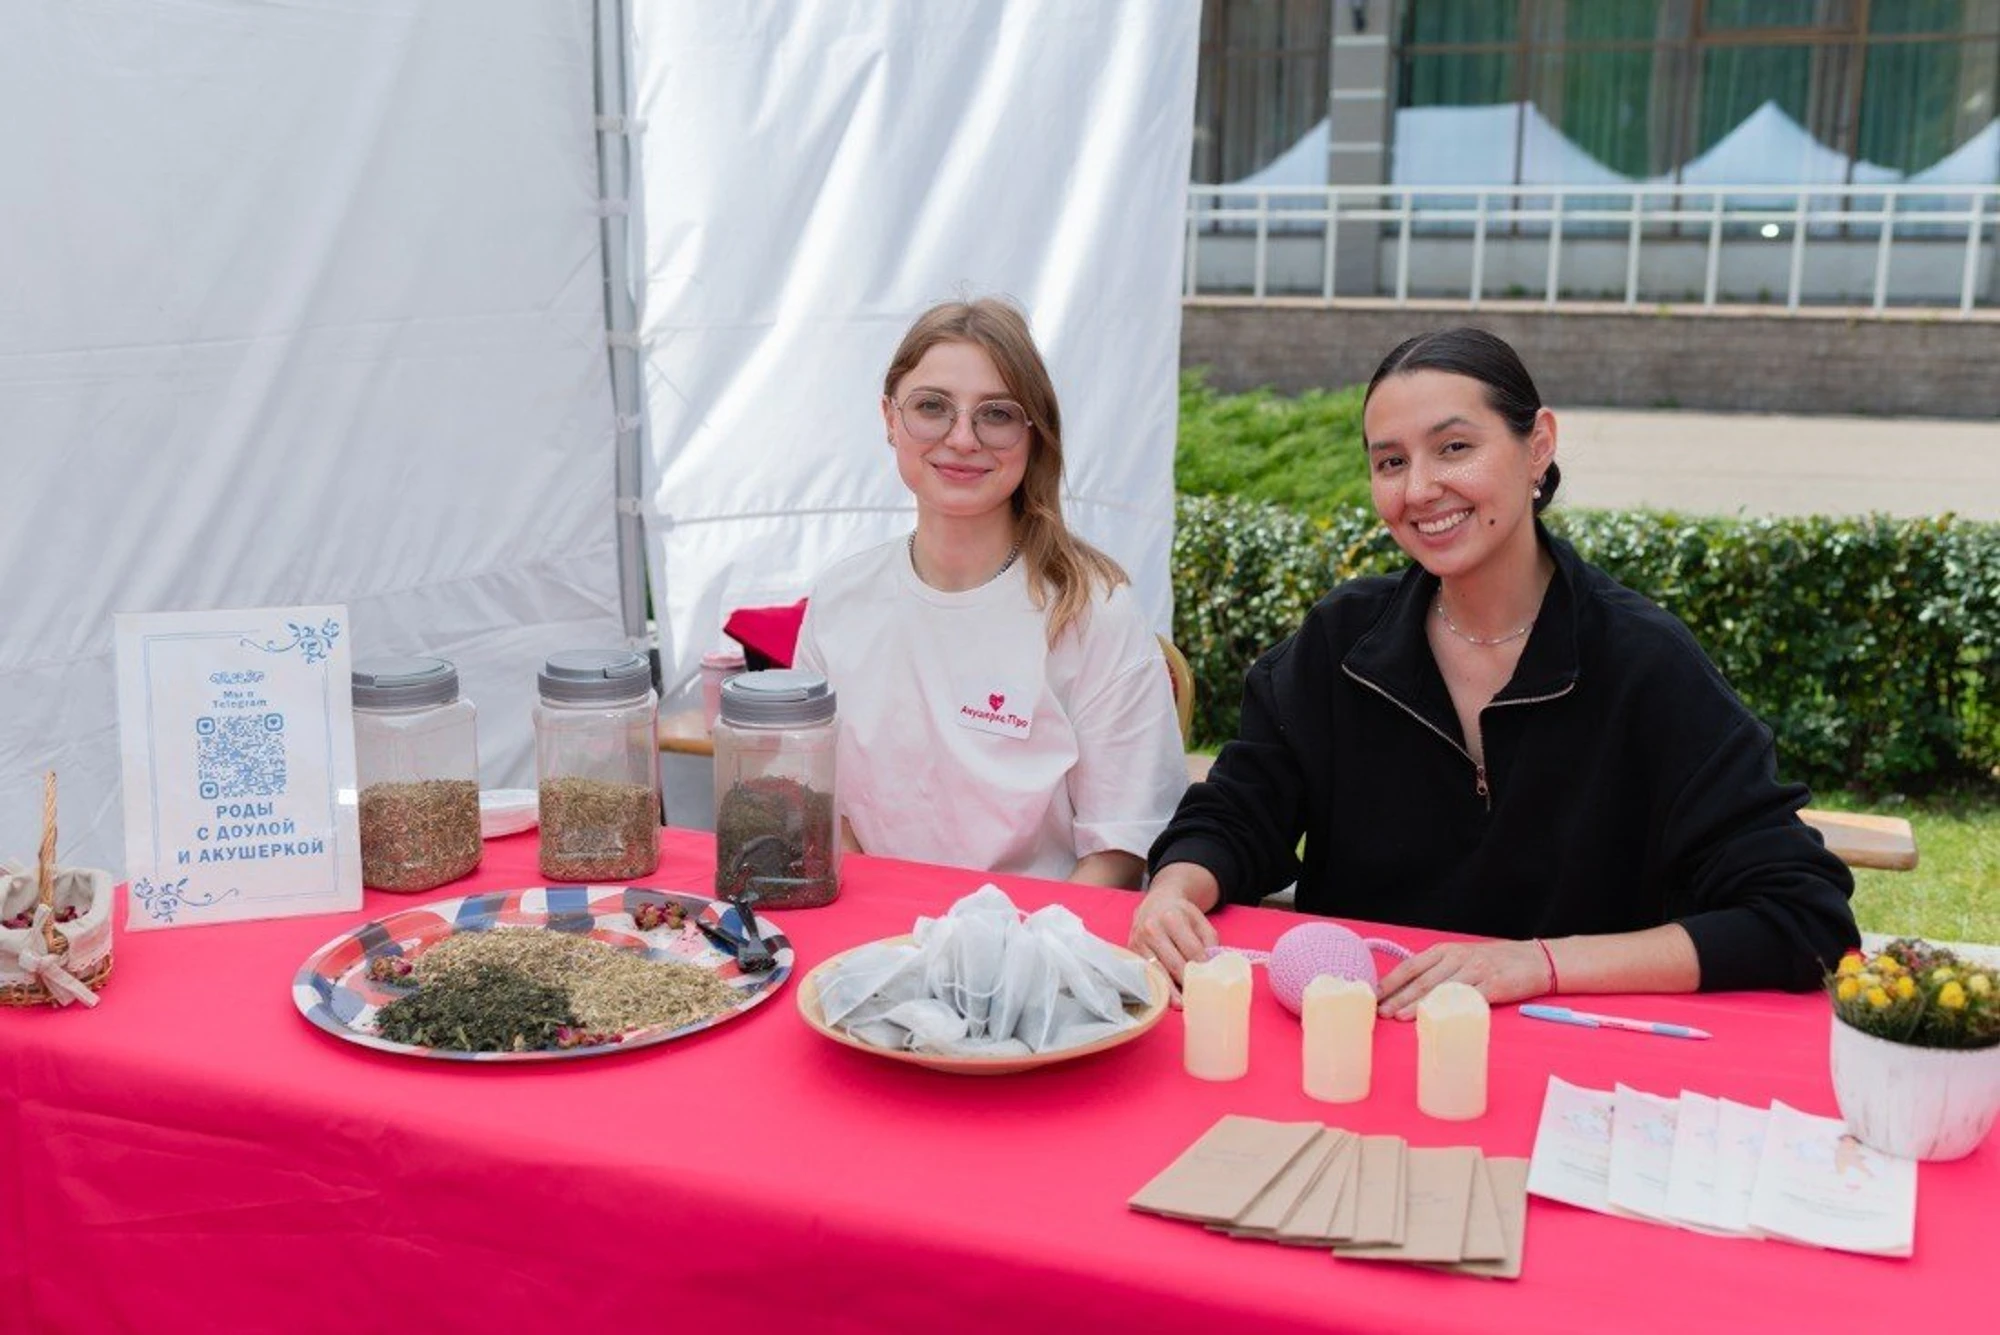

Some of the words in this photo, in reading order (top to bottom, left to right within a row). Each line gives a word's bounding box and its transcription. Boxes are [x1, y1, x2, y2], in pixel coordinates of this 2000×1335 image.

[212, 699, 267, 709] Telegram
[223, 690, 243, 700] Мы
[216, 802, 273, 820] РОДЫ
[197, 827, 209, 841] С
[216, 819, 295, 842] ДОУЛОЙ
[177, 850, 190, 865] И
[198, 838, 324, 864] АКУШЕРКОЙ
